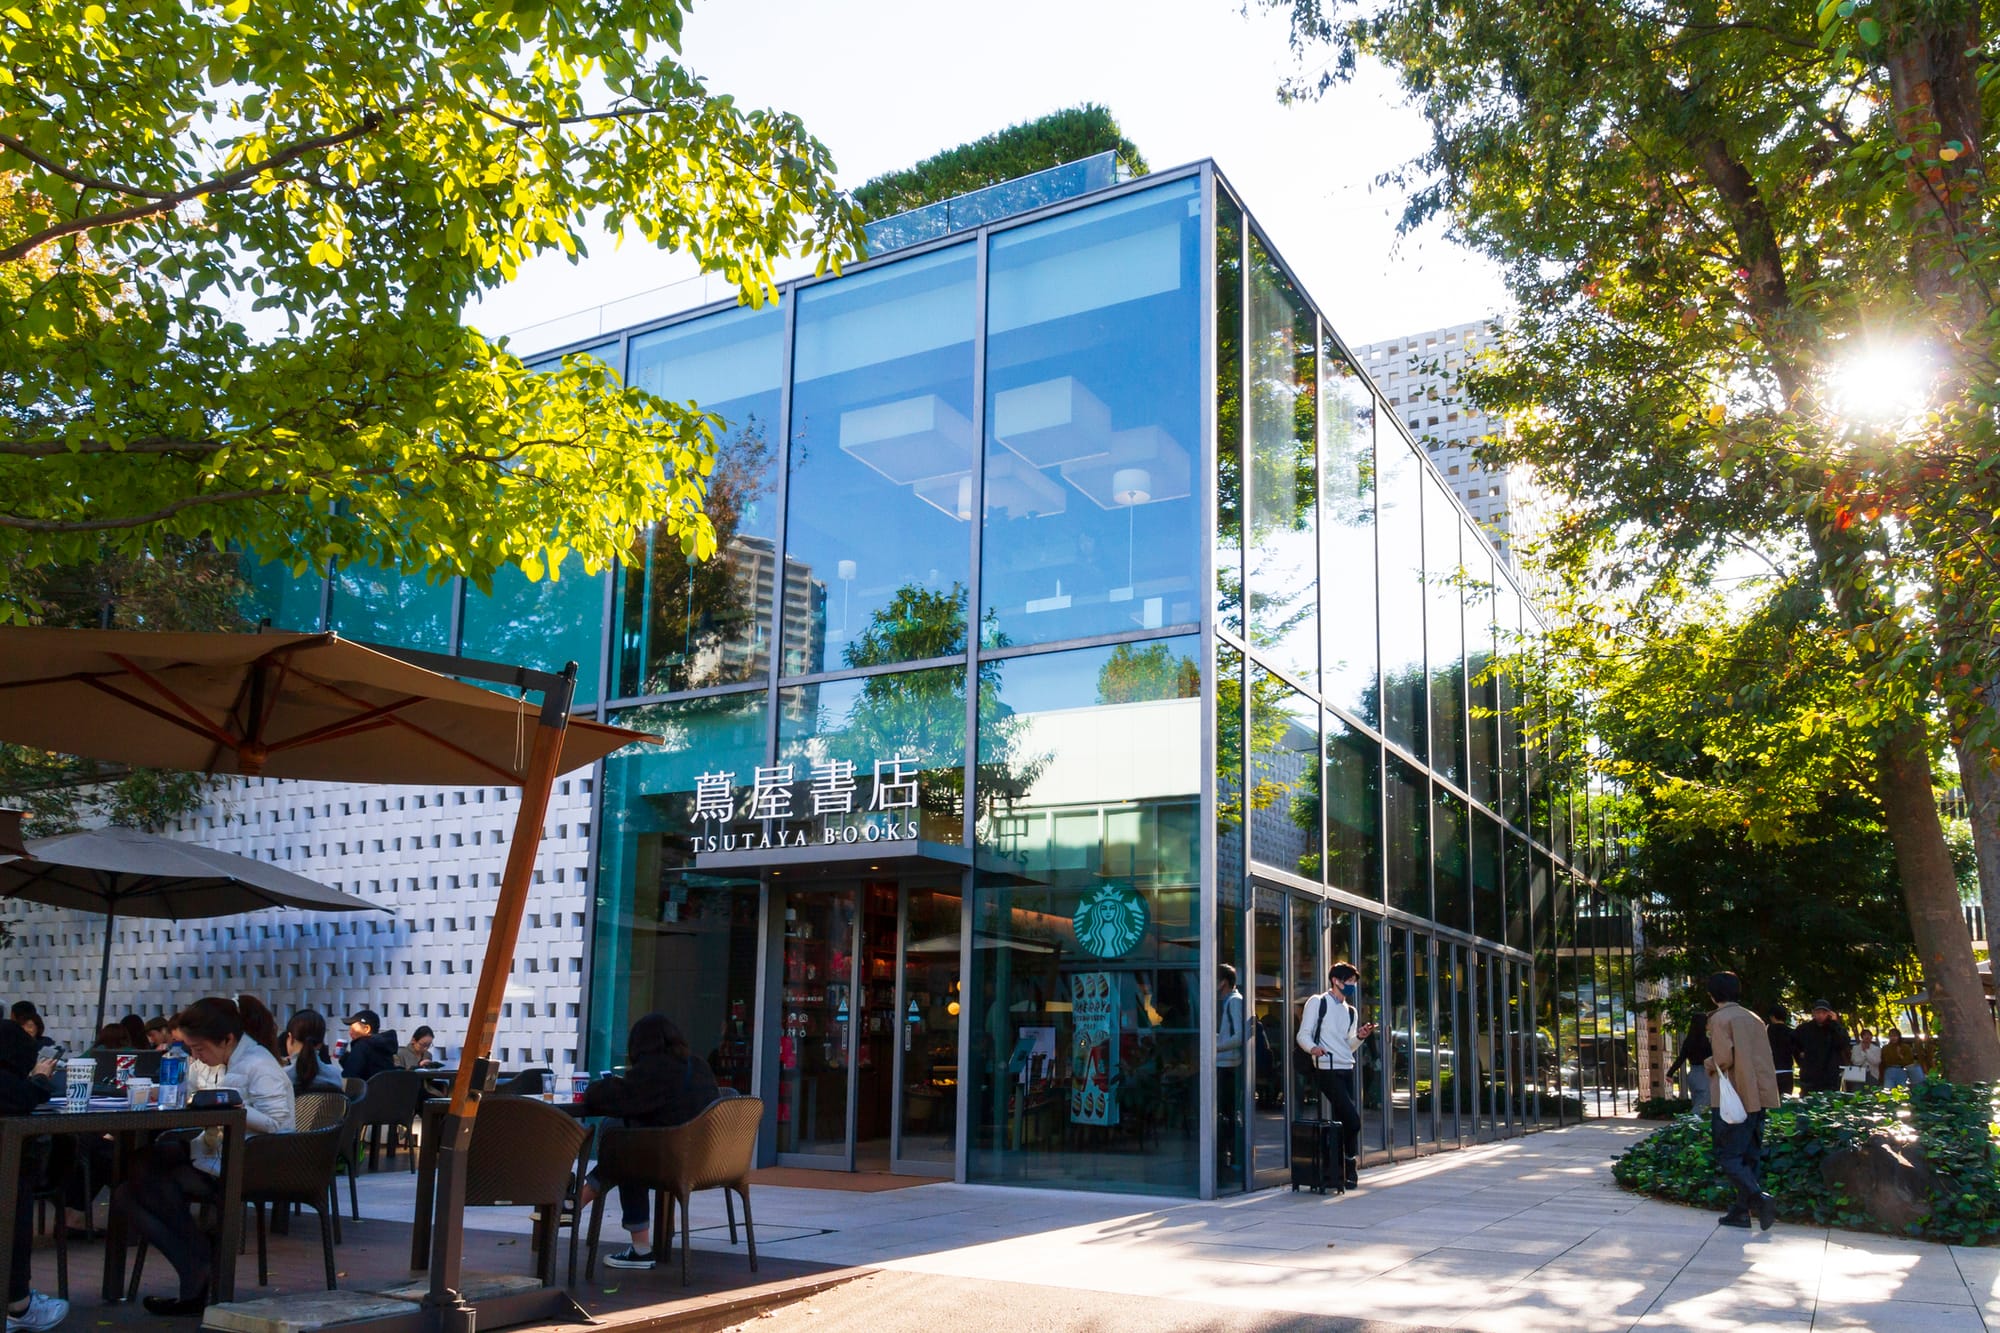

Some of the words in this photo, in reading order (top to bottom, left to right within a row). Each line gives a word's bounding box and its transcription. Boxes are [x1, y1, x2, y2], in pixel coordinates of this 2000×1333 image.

[690, 752, 921, 825] 蔦屋書店
[690, 830, 807, 853] TSUTAYA
[824, 821, 919, 846] BOOKS
